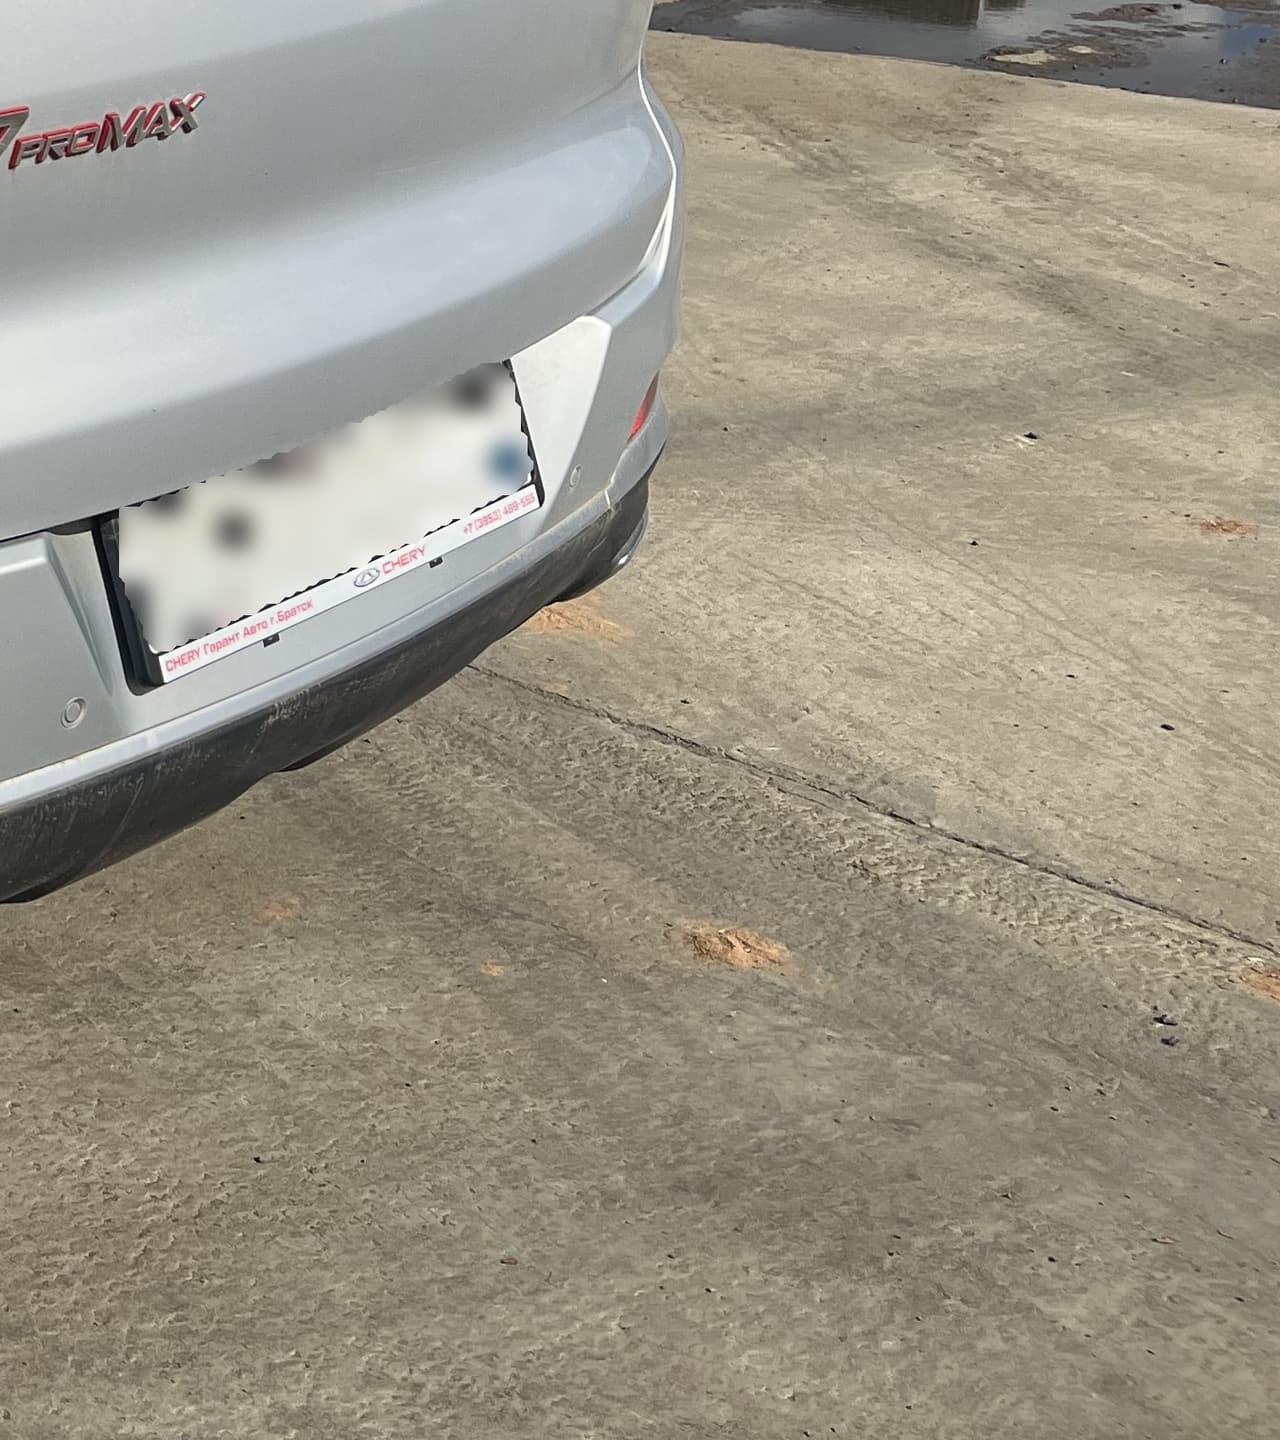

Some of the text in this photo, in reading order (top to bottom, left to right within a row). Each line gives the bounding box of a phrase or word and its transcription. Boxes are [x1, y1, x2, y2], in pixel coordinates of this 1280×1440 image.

[382, 545, 427, 575] CHERY
[165, 646, 201, 673] CHERY
[203, 631, 241, 656] Гарант
[243, 619, 269, 639] Авто
